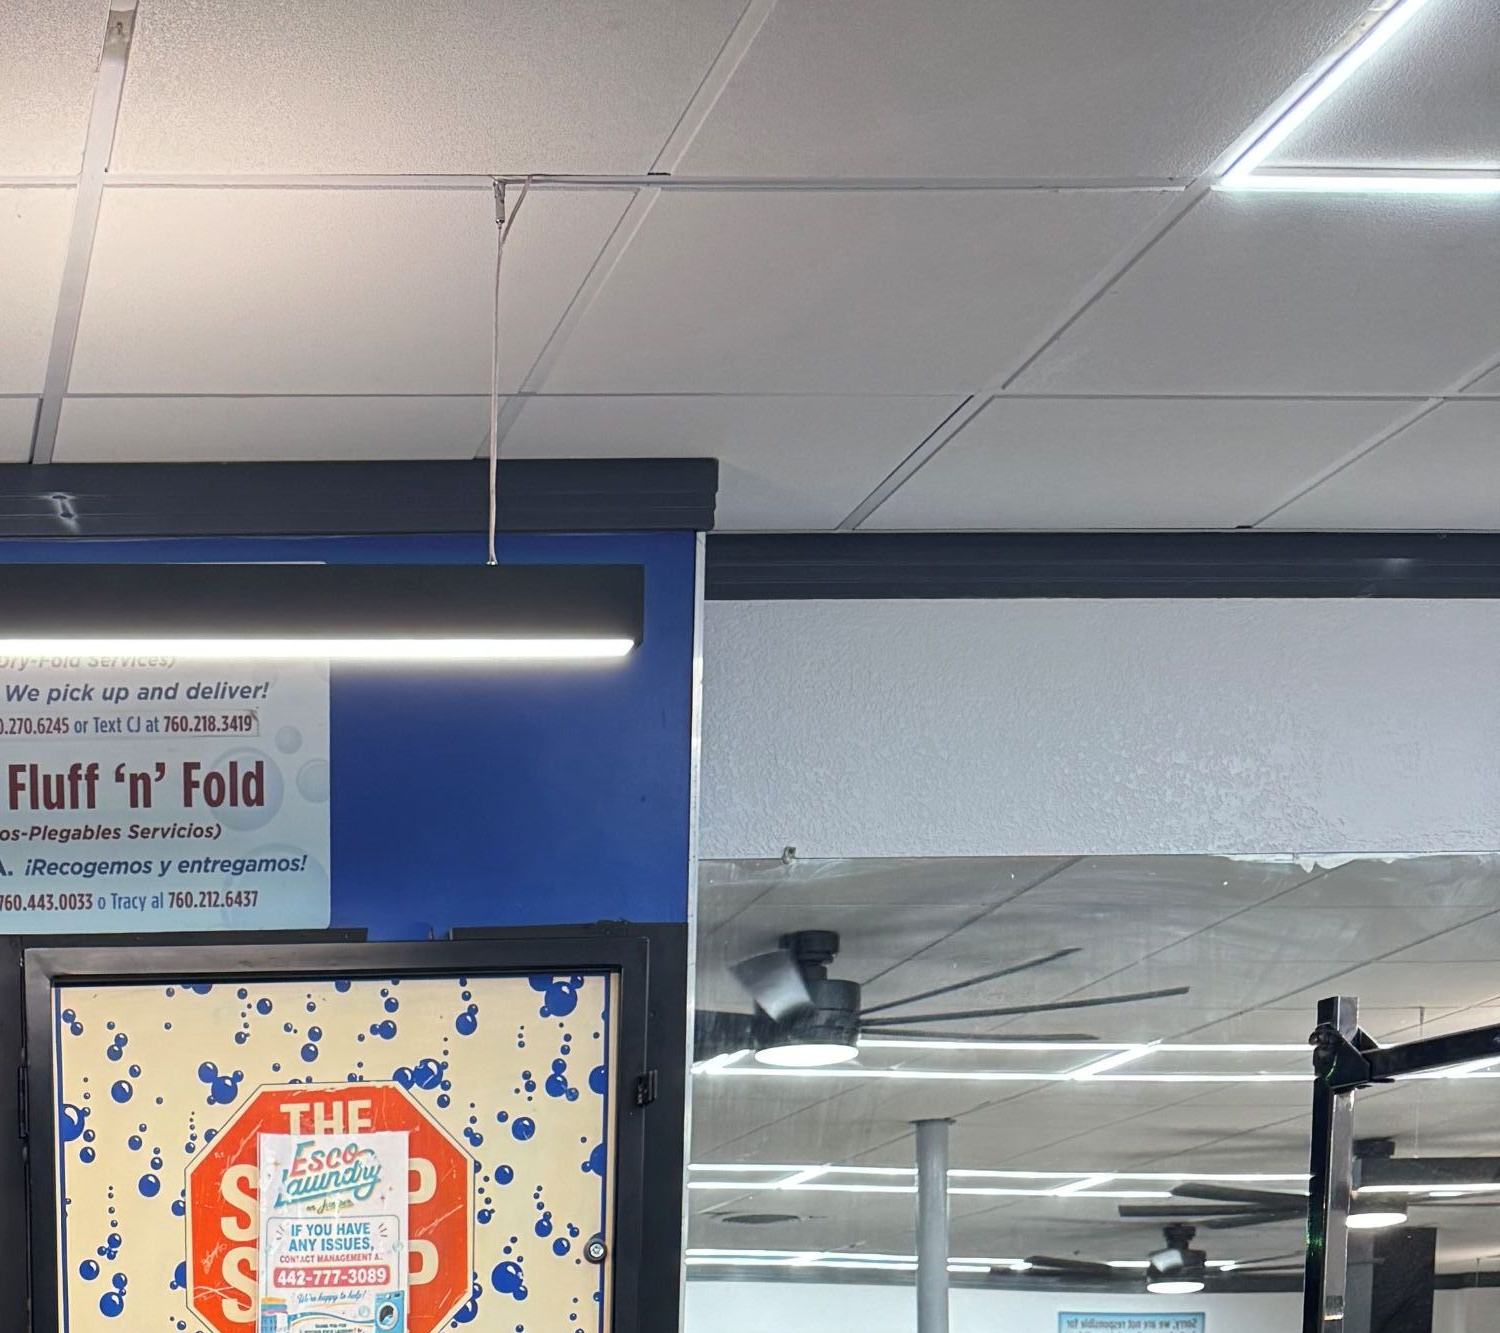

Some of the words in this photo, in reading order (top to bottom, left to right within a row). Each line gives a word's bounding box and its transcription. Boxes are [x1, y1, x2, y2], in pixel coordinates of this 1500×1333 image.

[6, 685, 39, 702] We
[47, 684, 94, 705] pick
[102, 687, 129, 704] up
[137, 683, 179, 700] and
[186, 682, 269, 699] deliver!
[74, 721, 88, 733] or
[93, 717, 122, 733] Text
[127, 716, 140, 733] CJ
[146, 717, 159, 732] at
[163, 715, 252, 733] 760.218.3419
[9, 763, 99, 810] Fluff
[183, 761, 264, 807] Fold
[128, 823, 221, 840] Servicios)
[25, 859, 152, 878] ¡Recogemos
[158, 860, 172, 877] y
[178, 855, 307, 875] entregamos!
[98, 897, 106, 909] o
[111, 893, 146, 911] Tracy
[151, 892, 163, 908] al
[168, 891, 258, 908] 760.212.6437
[291, 1224, 302, 1236] IF
[306, 1223, 332, 1236] YOU
[336, 1222, 370, 1235] HAVE
[288, 1239, 317, 1251] ANY
[321, 1237, 374, 1251] ISSUES,
[317, 1253, 372, 1263] MANAGEMENT
[278, 1268, 387, 1286] 442-777-3089
